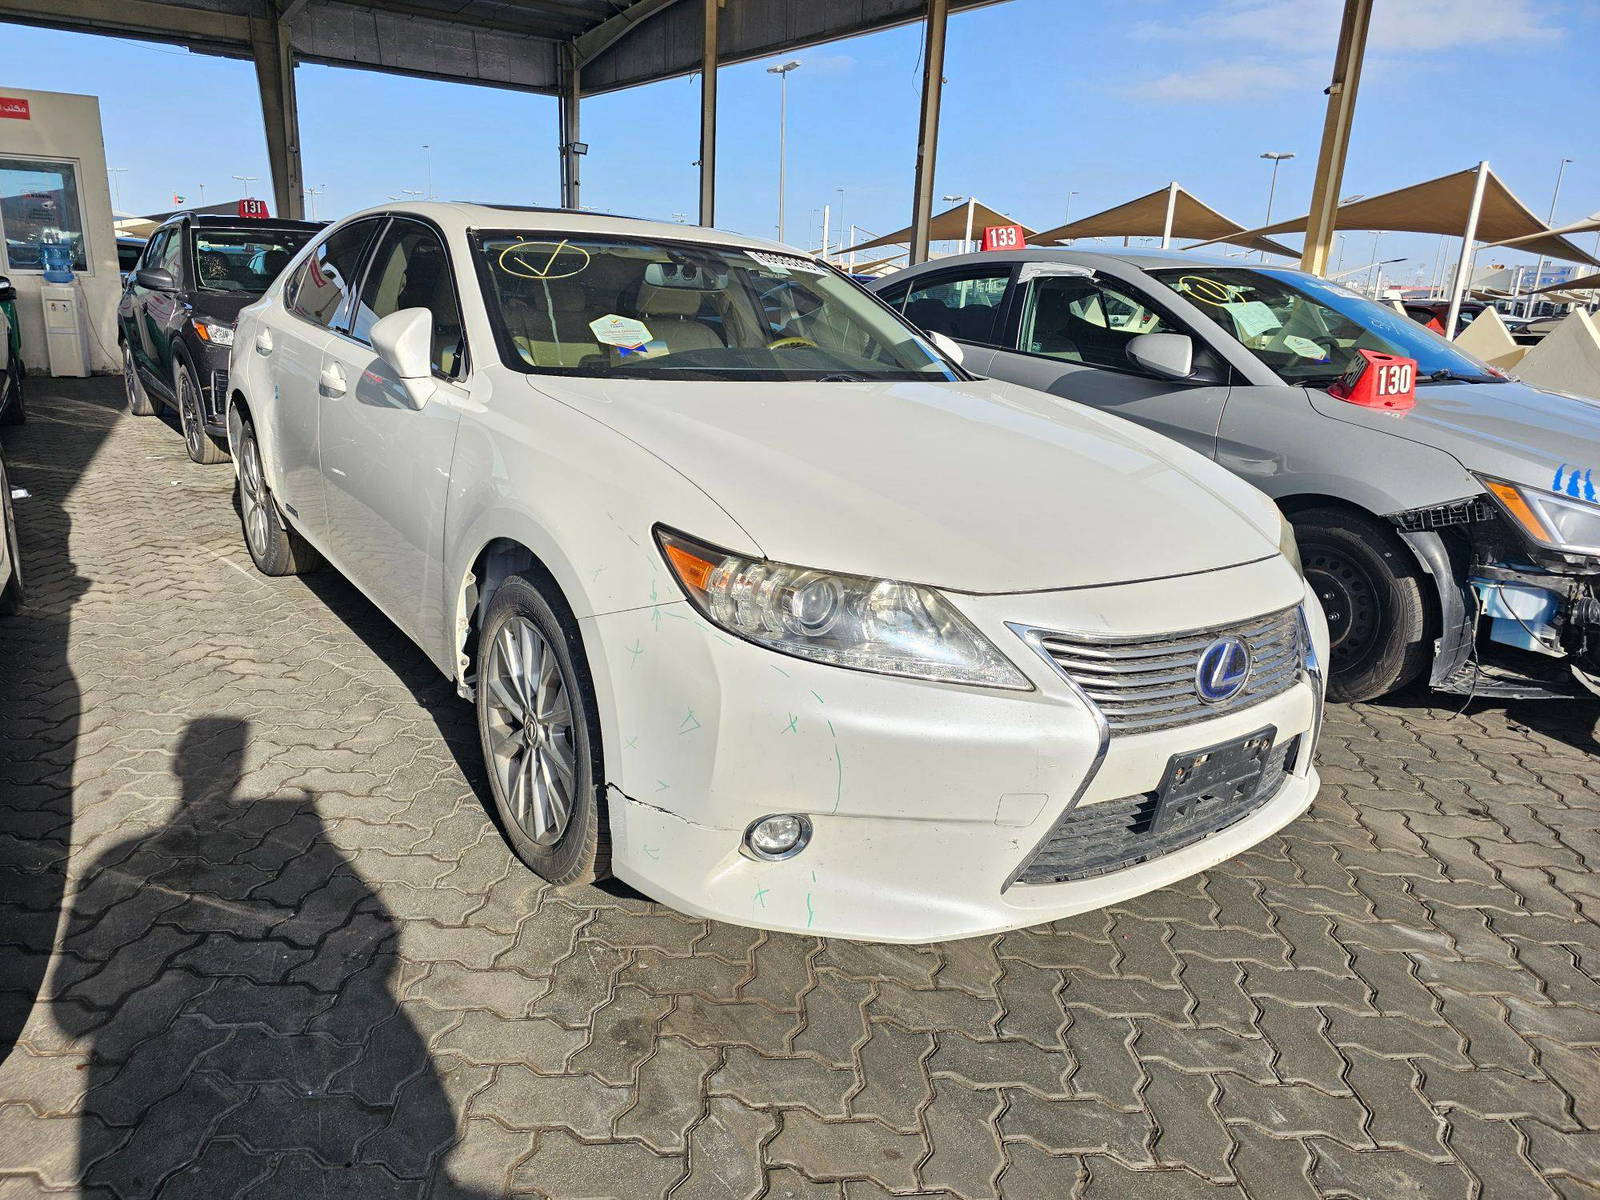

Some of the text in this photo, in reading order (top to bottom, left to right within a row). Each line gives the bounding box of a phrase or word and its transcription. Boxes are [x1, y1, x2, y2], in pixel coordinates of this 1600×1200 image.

[243, 201, 262, 214] 131
[990, 227, 1017, 248] 133
[1378, 364, 1412, 395] 130
